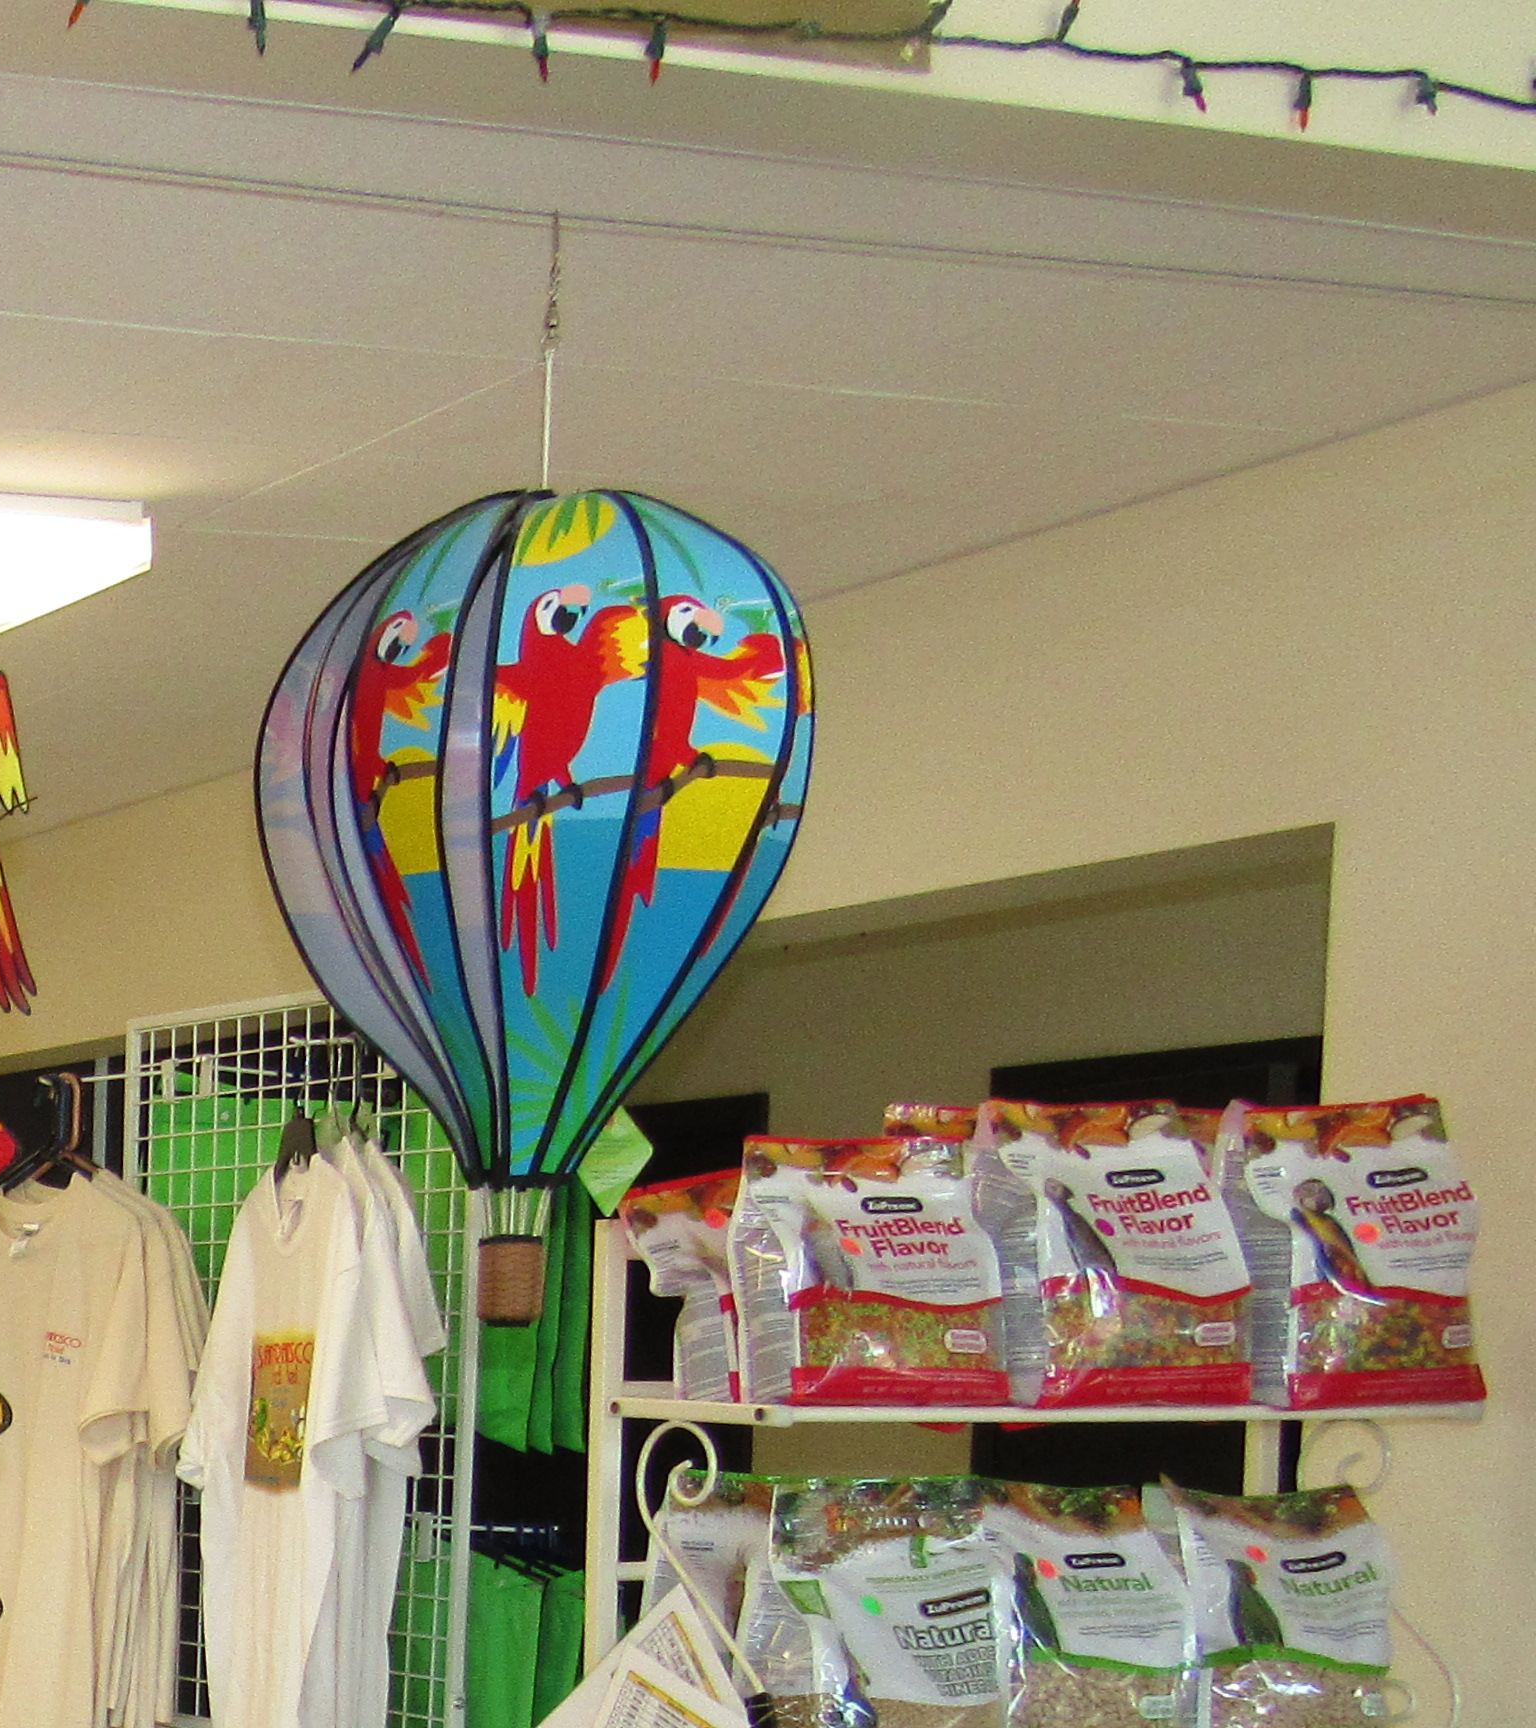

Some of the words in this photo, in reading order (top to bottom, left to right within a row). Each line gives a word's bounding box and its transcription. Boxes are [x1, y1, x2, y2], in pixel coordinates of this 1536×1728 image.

[1087, 1182, 1212, 1214] FruitBlend
[1345, 1181, 1475, 1216] FruitBlend
[835, 1216, 966, 1239] FruitBlend
[1118, 1212, 1195, 1235] Flavor
[1381, 1211, 1459, 1235] Flavor
[869, 1237, 949, 1258] Flavor
[1059, 1571, 1154, 1593] Natural
[1279, 1561, 1378, 1596] Natural
